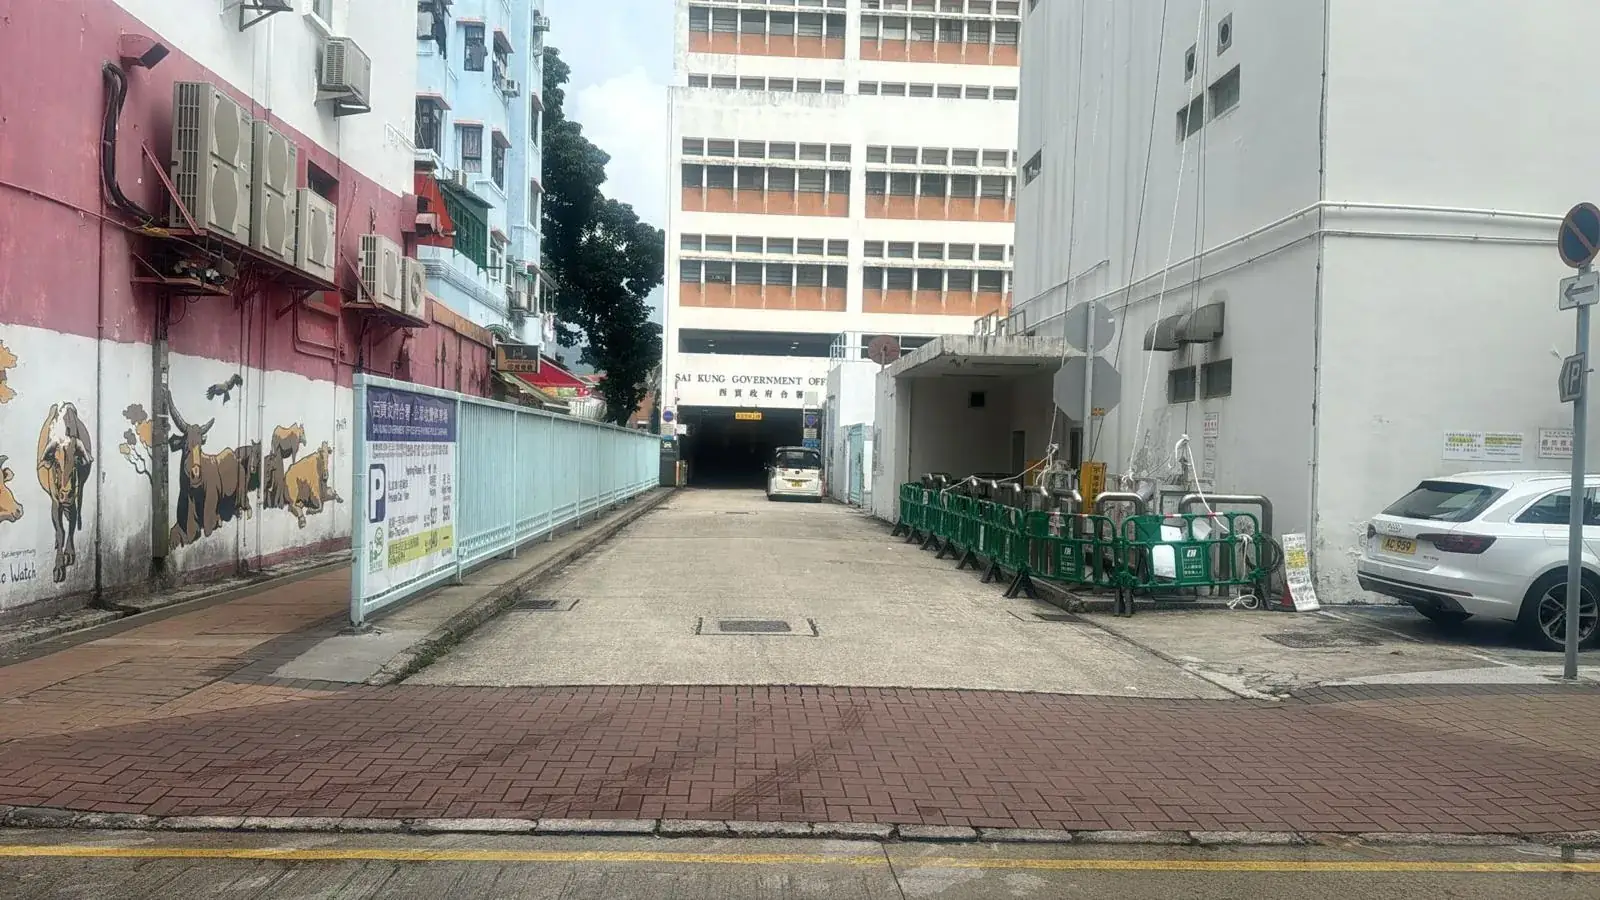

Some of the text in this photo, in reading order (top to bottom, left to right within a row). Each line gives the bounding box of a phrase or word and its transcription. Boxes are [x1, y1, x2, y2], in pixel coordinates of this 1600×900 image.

[675, 373, 827, 386] SAI KUNG GOVERNMENT OFF
[370, 466, 385, 520] P
[10, 561, 37, 583] Watch
